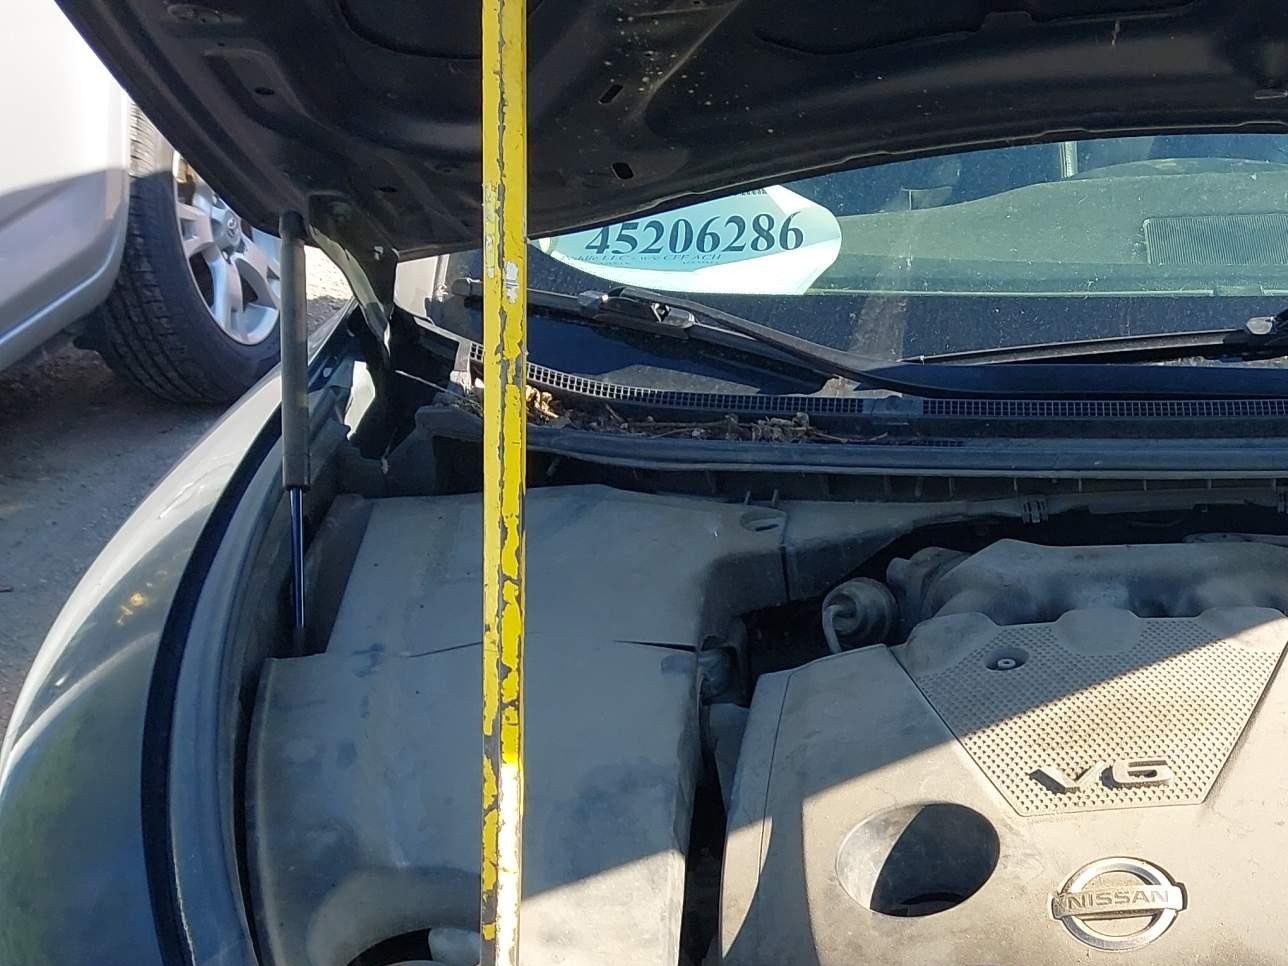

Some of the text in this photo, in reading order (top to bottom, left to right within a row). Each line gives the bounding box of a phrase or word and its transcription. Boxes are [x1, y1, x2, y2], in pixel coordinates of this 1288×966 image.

[585, 212, 804, 254] 45206286
[1029, 758, 1174, 795] V6
[1066, 889, 1169, 911] NISSAN
